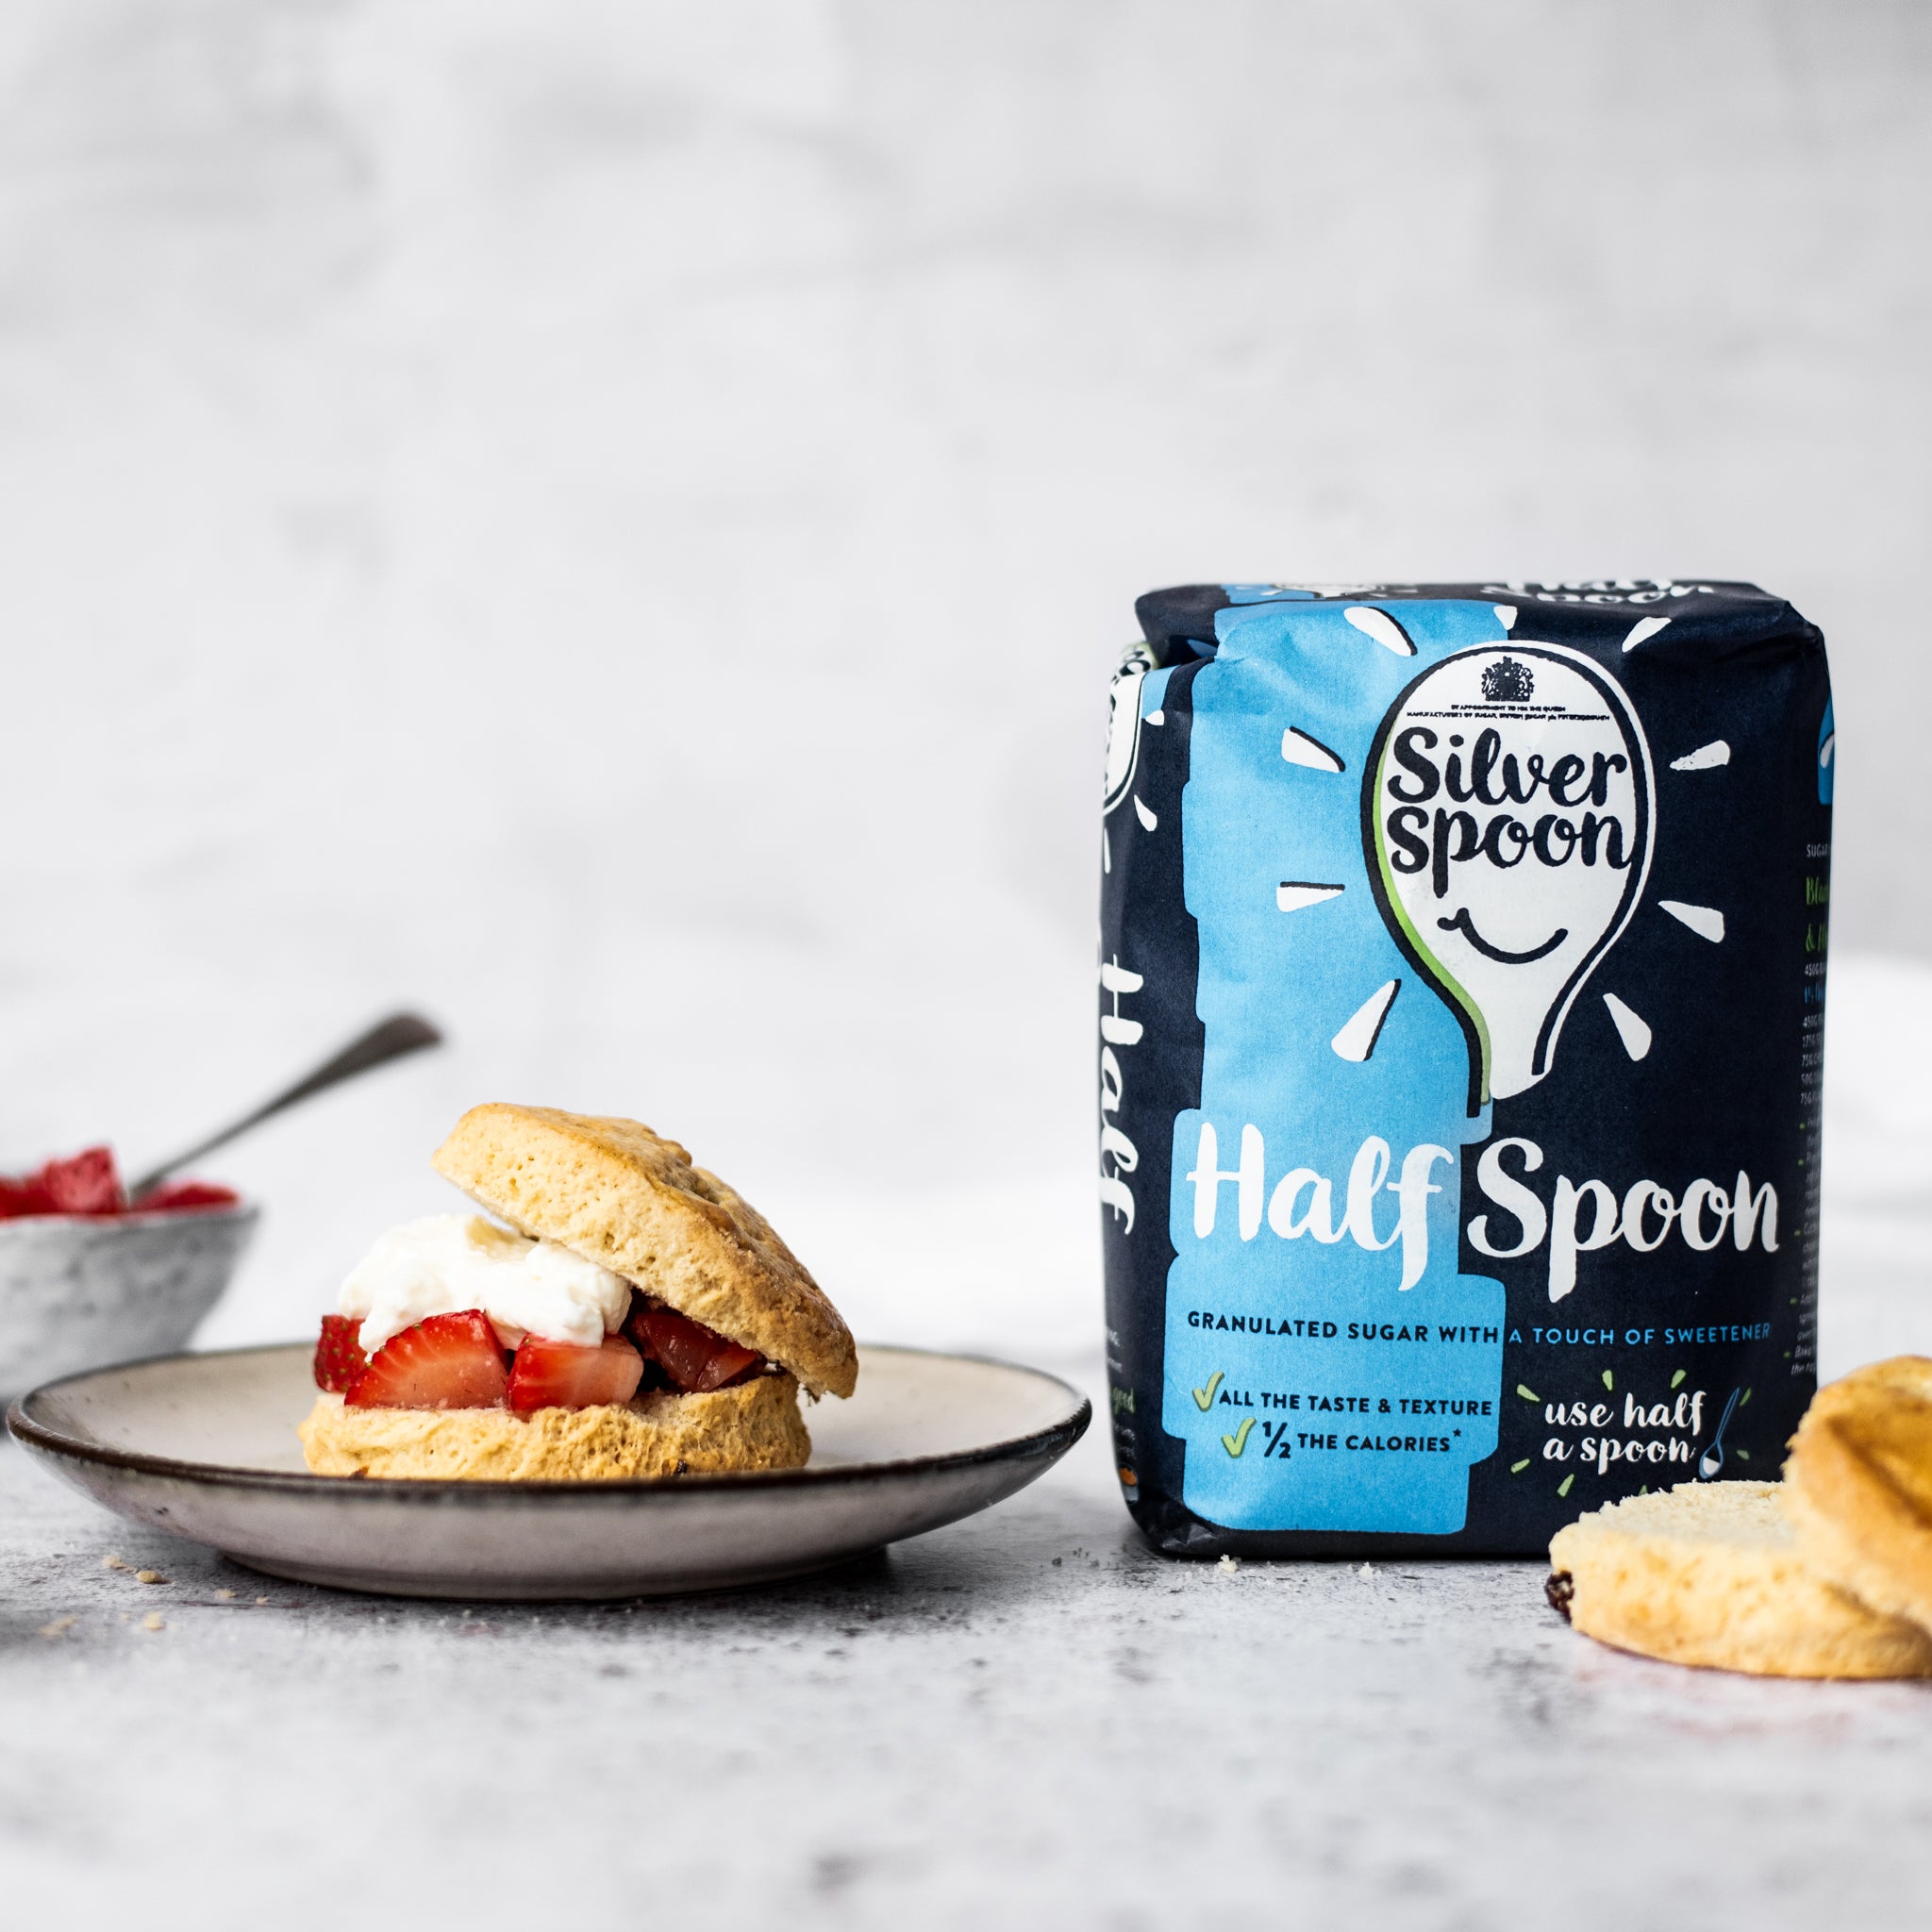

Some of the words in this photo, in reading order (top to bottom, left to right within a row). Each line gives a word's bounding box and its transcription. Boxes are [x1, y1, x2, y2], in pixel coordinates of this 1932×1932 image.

[1387, 726, 1628, 808] Silver
[1185, 1122, 1455, 1291] Half
[1467, 1137, 1779, 1303] Spoon
[1188, 1311, 1337, 1338] GRANULATED
[1348, 1323, 1427, 1341] SUGAR
[1439, 1325, 1498, 1343] WITH
[1509, 1329, 1522, 1342] A
[1533, 1328, 1613, 1344] TOUCH
[1624, 1328, 1655, 1344] OF
[1665, 1323, 1771, 1344] SWEETENER
[1219, 1391, 1254, 1407] ALL
[1261, 1392, 1300, 1409] THE
[1307, 1396, 1370, 1413] TASTE
[1378, 1398, 1391, 1413] &
[1399, 1399, 1492, 1416] TEXTURE
[1545, 1401, 1614, 1426] use
[1624, 1391, 1707, 1436] half
[1297, 1433, 1337, 1450] THE
[1542, 1438, 1574, 1461] a
[1580, 1437, 1696, 1475] spoon
